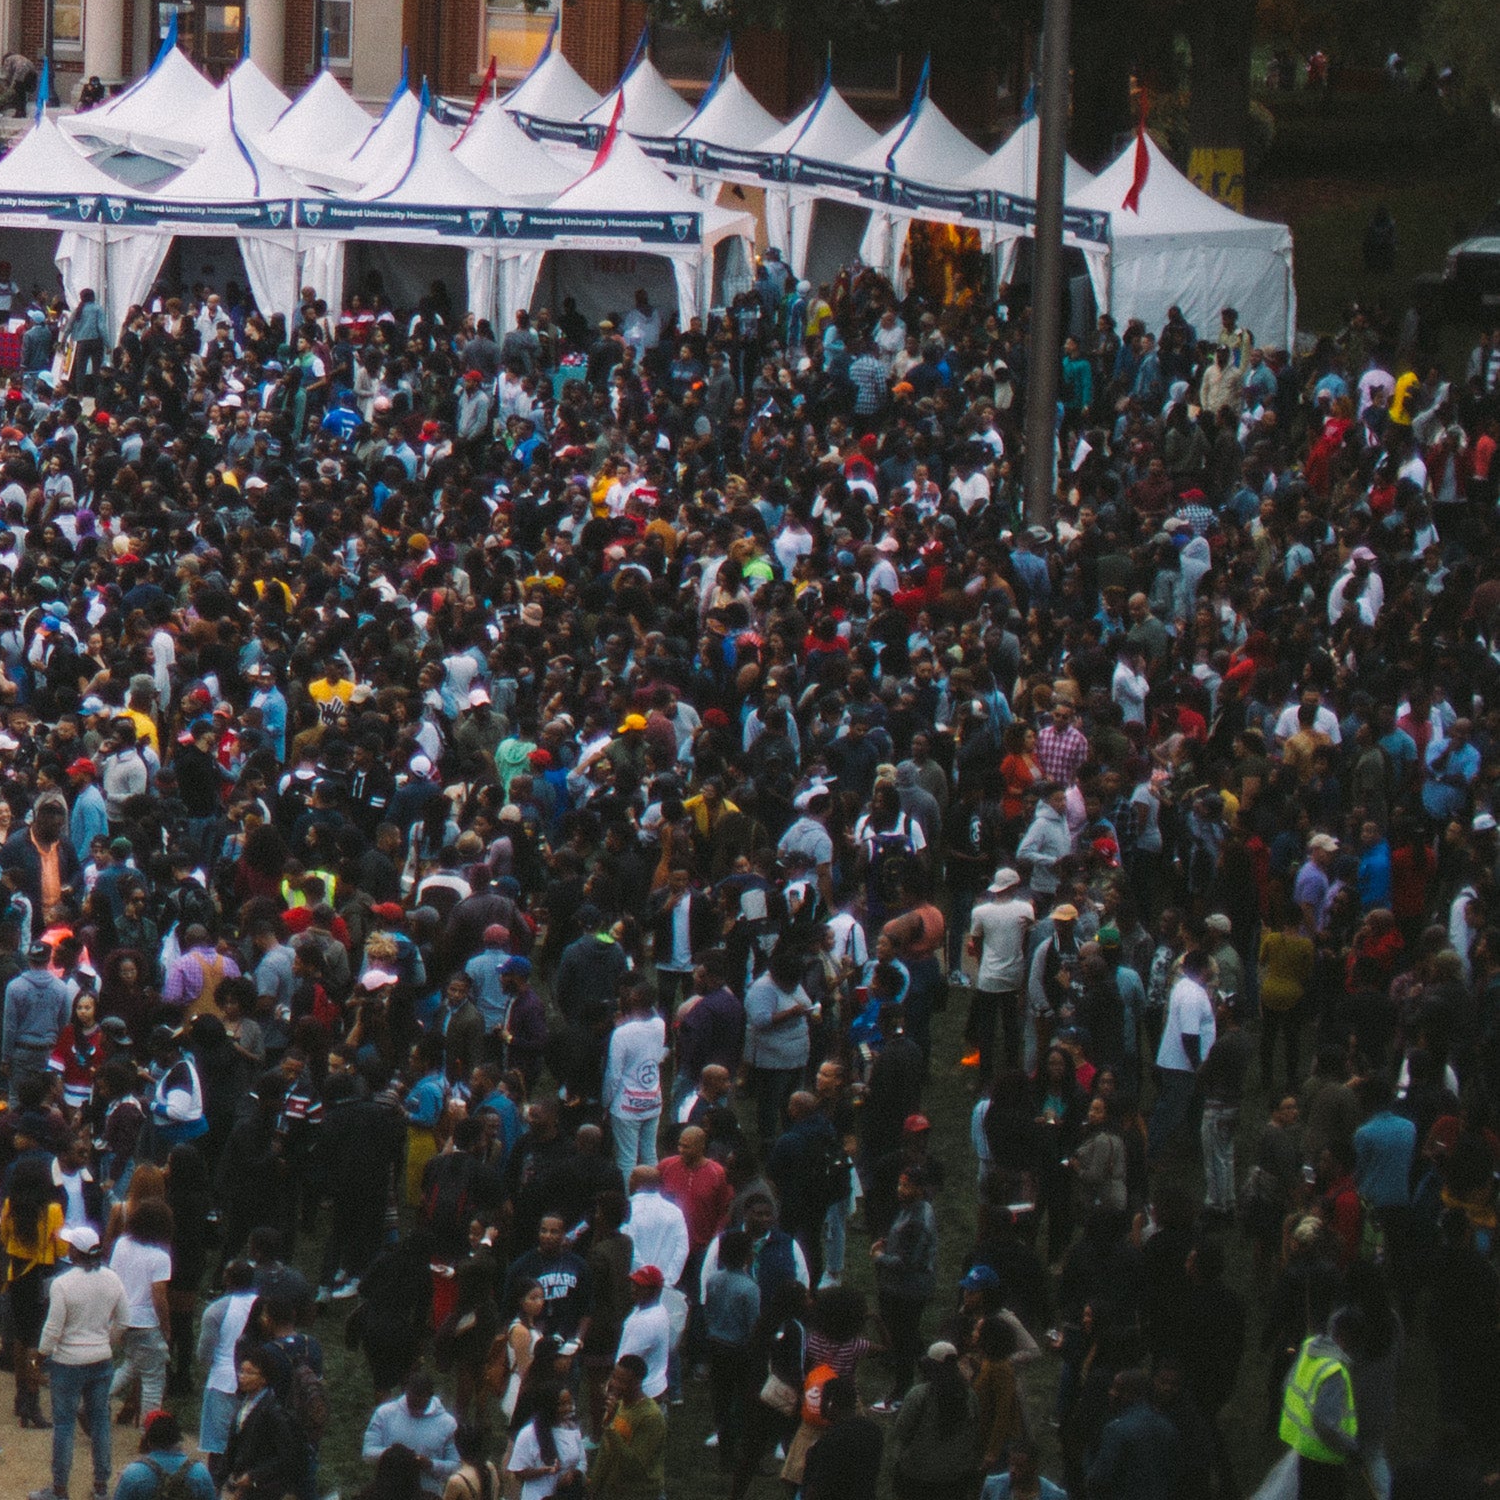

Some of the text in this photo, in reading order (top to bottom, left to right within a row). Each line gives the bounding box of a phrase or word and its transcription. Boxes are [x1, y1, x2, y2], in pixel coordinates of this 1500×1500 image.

[18, 199, 71, 209] Homecoming
[133, 203, 261, 217] Howard University Homecoming
[330, 208, 463, 223] Howard University Homecoming
[529, 216, 665, 230] Howard University Homecoming
[537, 1272, 577, 1288] OWARD
[544, 1285, 568, 1300] LAW
